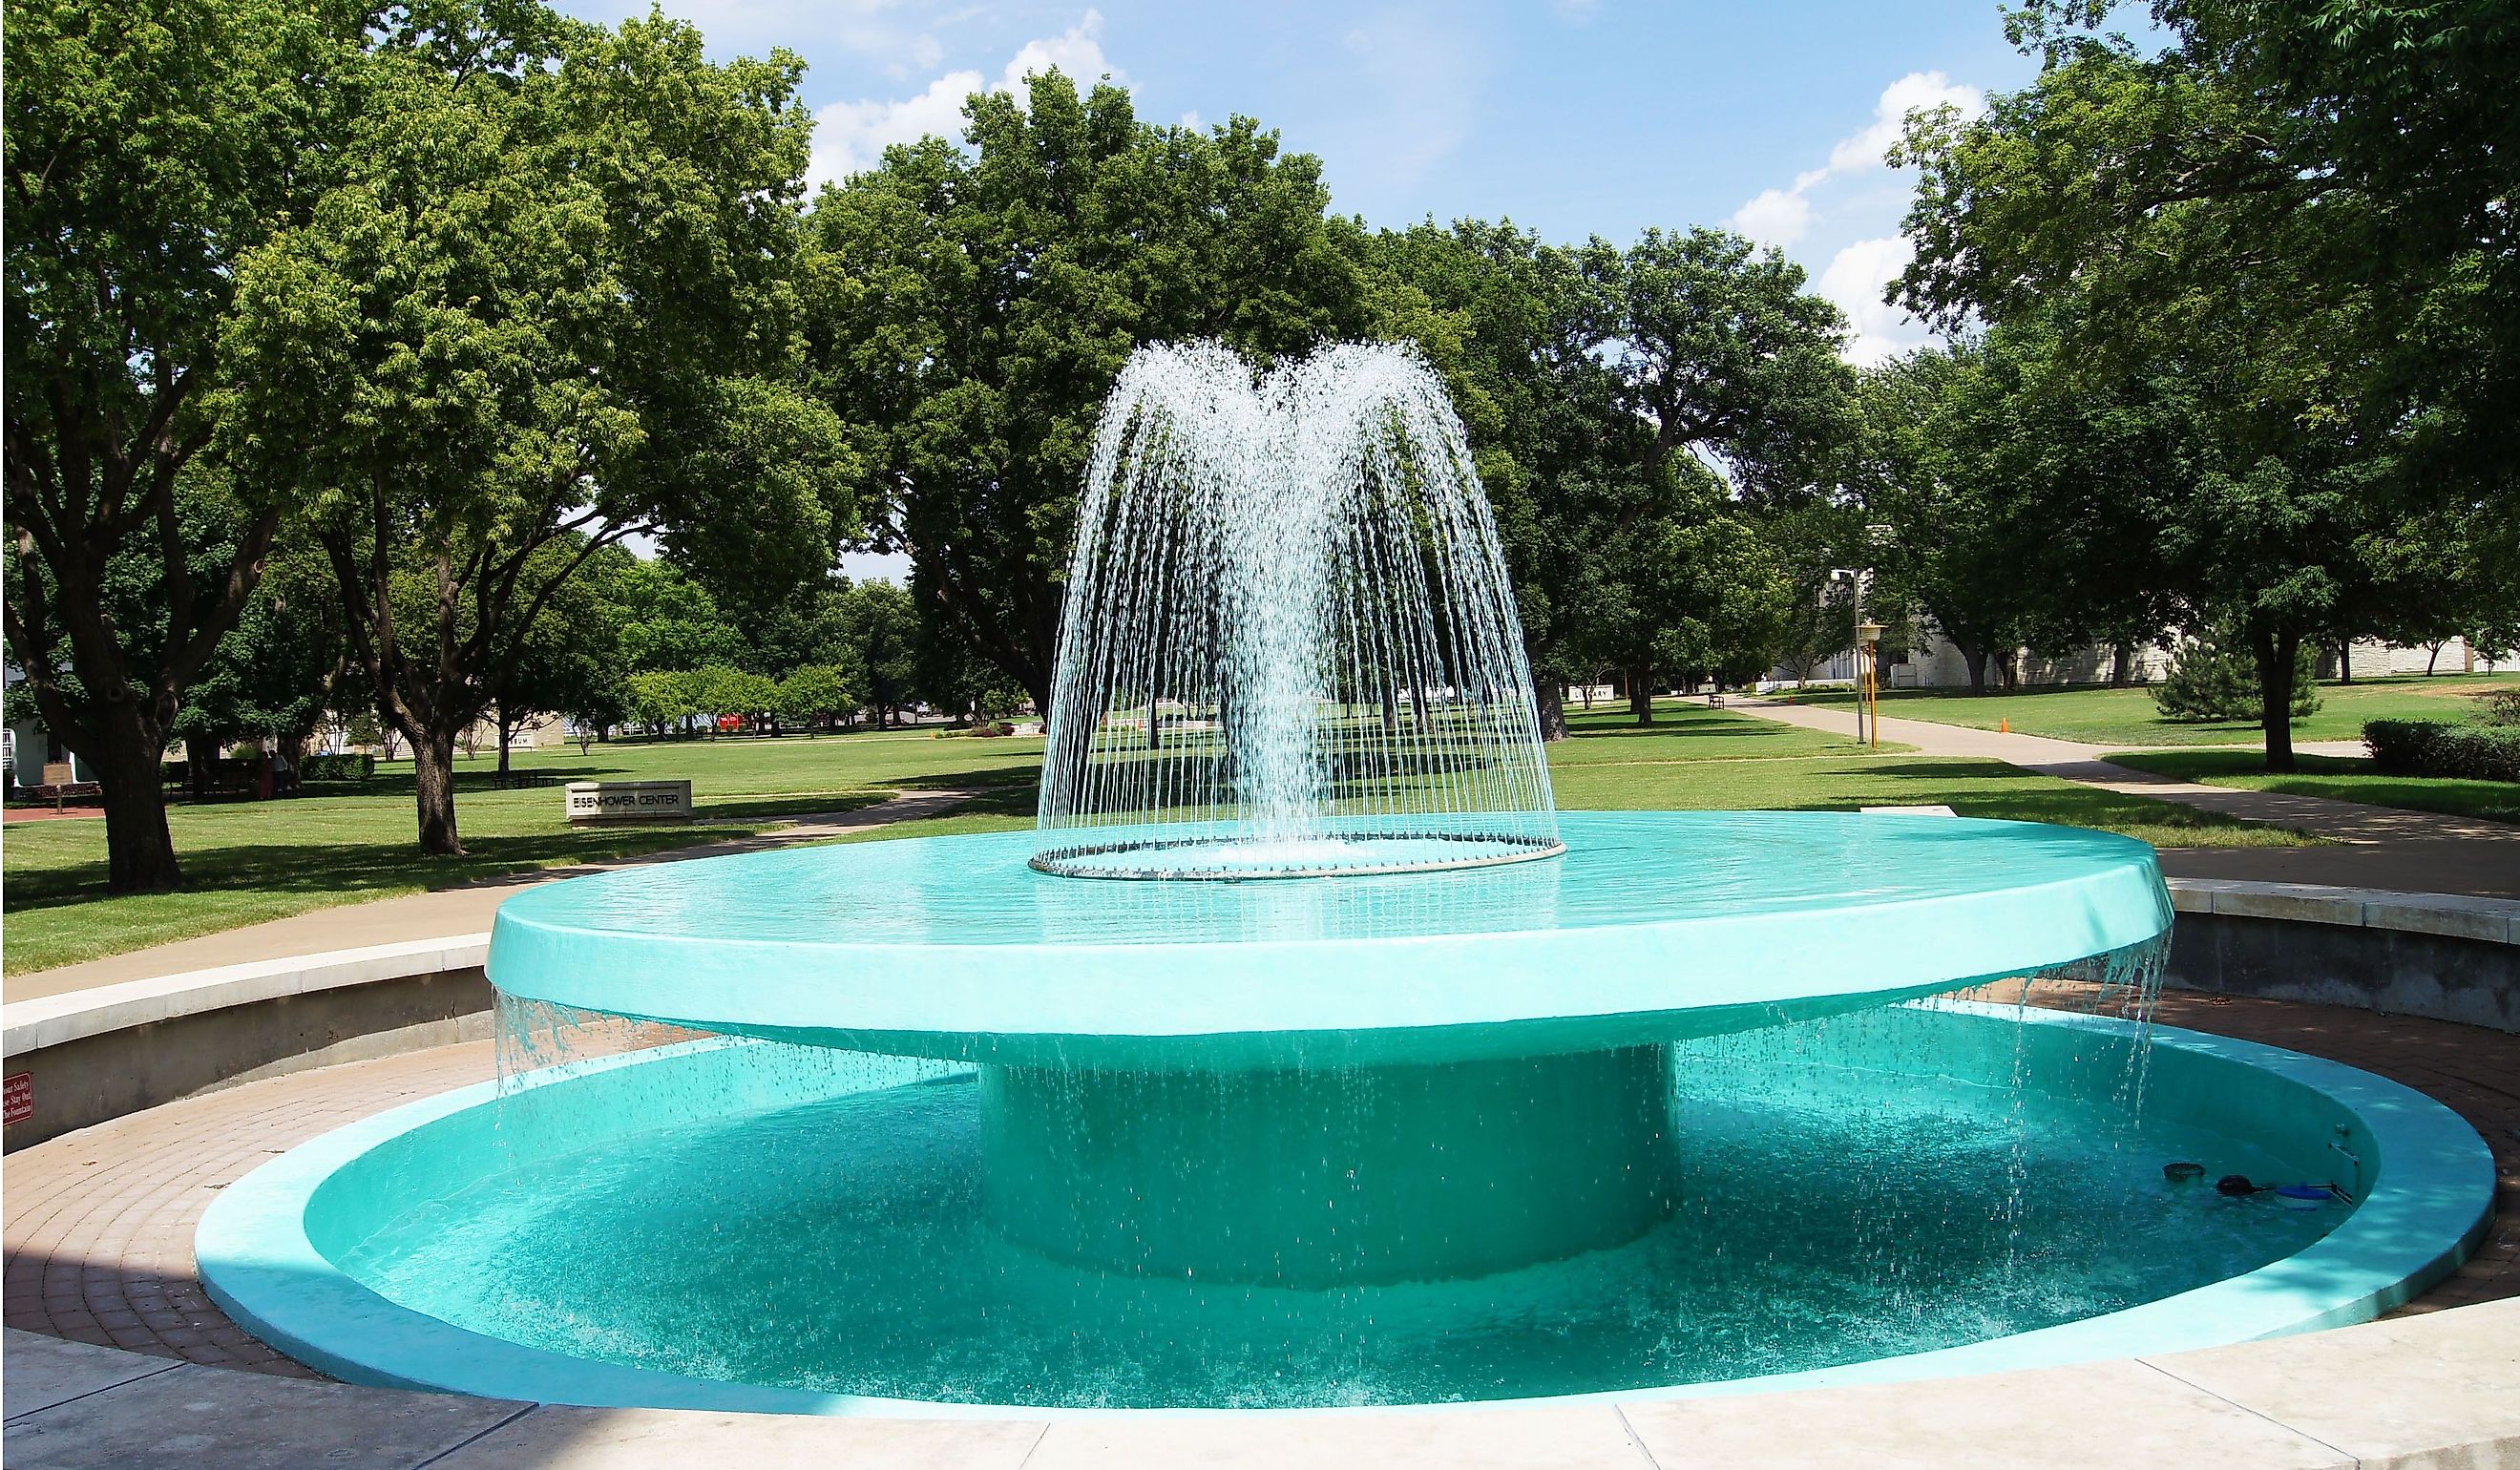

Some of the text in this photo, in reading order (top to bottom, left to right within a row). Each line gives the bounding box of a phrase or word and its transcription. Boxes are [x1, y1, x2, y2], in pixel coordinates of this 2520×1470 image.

[574, 794, 680, 808] EISENHOWER CENTER
[13, 1081, 29, 1091] Safety
[10, 1095, 21, 1105] Stay
[21, 1092, 32, 1101] Out
[10, 1105, 31, 1117] Fountain
